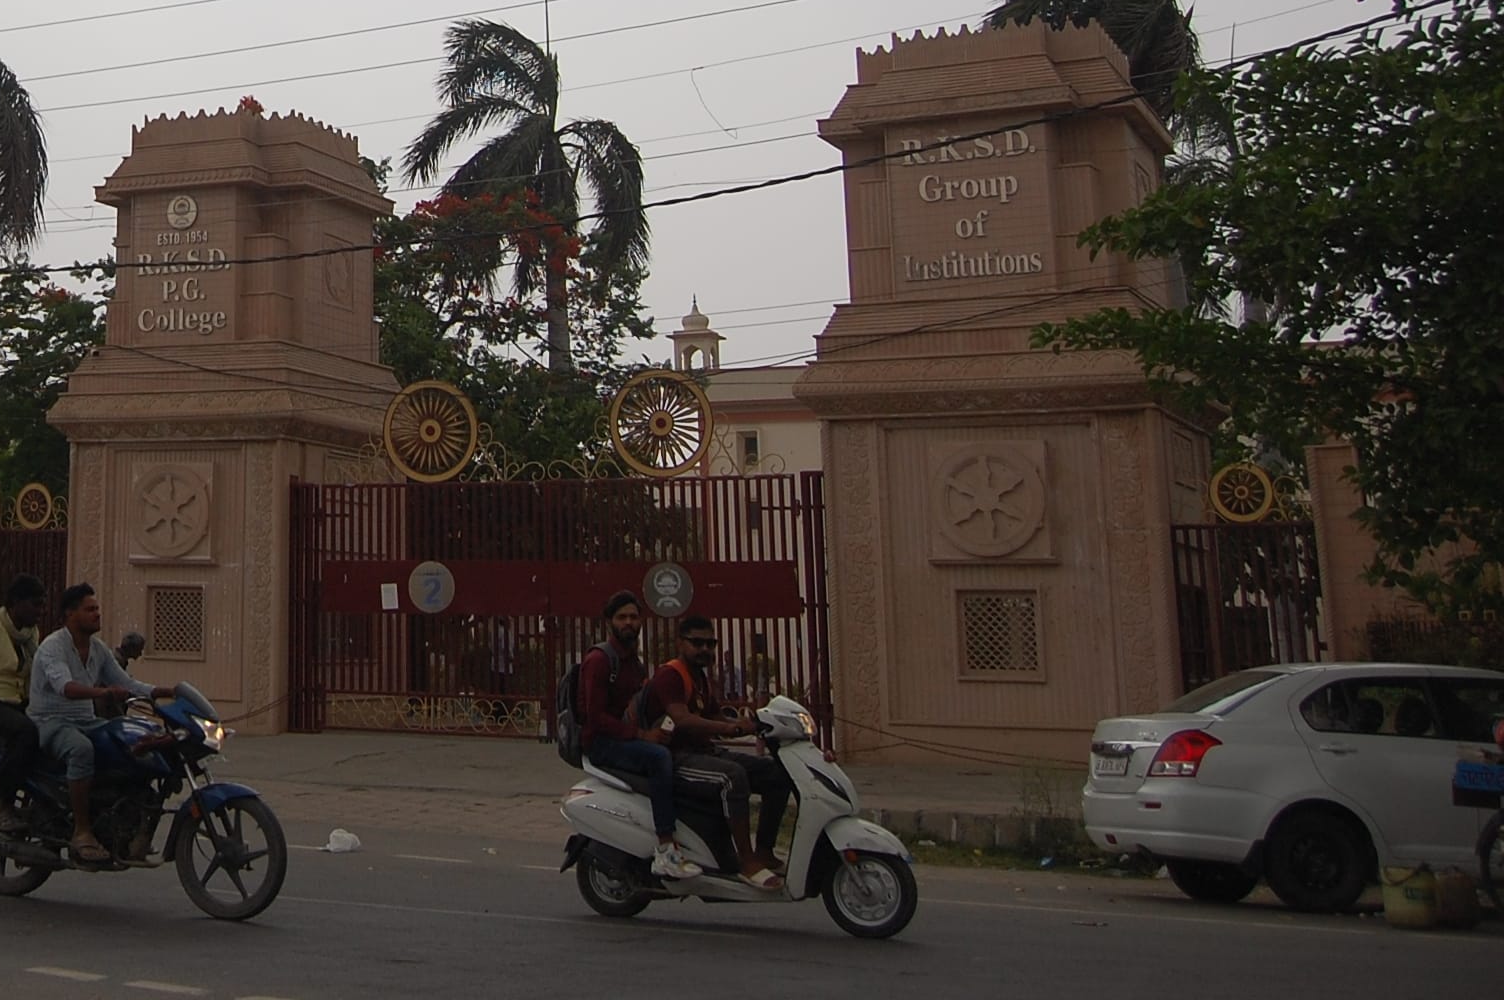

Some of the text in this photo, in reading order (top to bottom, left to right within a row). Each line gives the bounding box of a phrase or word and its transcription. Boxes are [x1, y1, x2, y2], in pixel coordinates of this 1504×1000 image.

[901, 129, 1036, 166] R.K.S.D.
[919, 175, 1018, 203] Group
[157, 230, 209, 246] ESTD. 1954
[955, 210, 989, 239] of
[137, 248, 231, 275] R.K.S.D.
[904, 250, 1043, 281] Institutions
[162, 277, 206, 302] P.G.
[138, 308, 227, 334] College
[424, 578, 442, 604] 2
